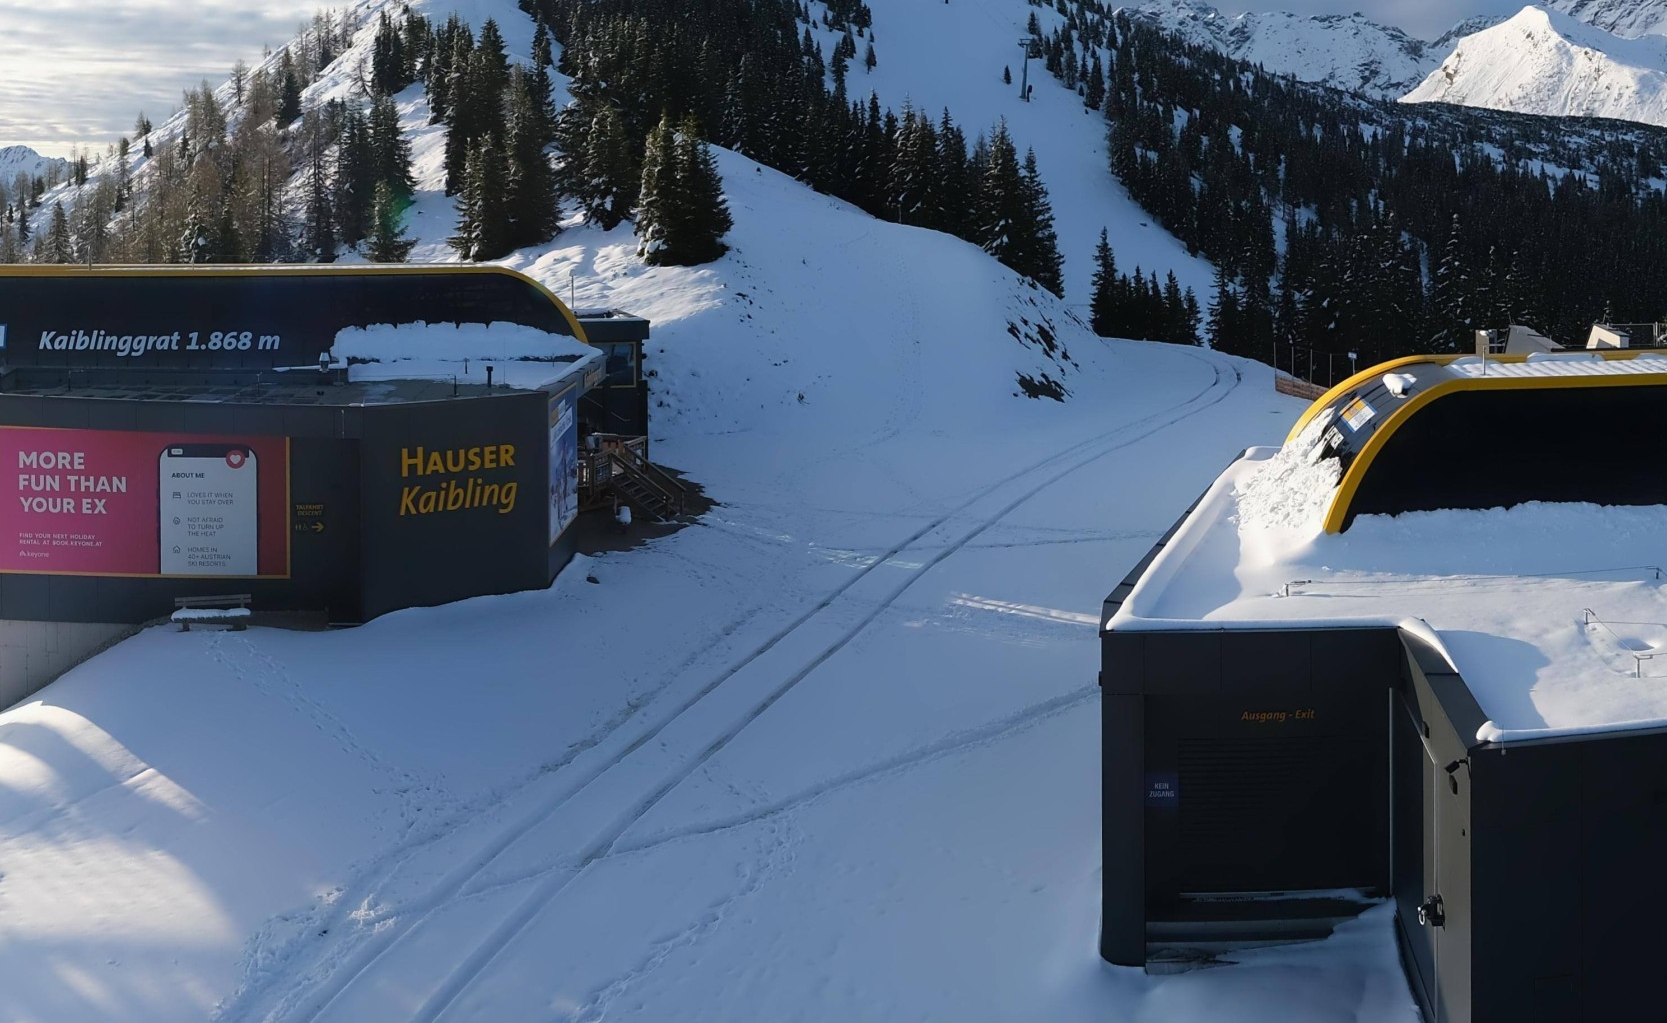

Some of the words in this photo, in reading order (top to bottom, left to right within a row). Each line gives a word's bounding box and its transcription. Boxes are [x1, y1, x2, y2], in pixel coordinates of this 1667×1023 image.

[38, 330, 181, 357] Kaiblinggrat
[186, 331, 252, 351] 1.868
[257, 333, 281, 351] m
[18, 451, 85, 470] MORE
[401, 444, 515, 477] HAUSER
[18, 474, 60, 492] FUN
[66, 475, 127, 493] THAN
[19, 496, 75, 514] YOUR
[82, 498, 107, 515] EX
[400, 477, 518, 516] Kaibling
[1241, 711, 1286, 723] Ausgang
[1295, 708, 1316, 719] Exit
[1149, 790, 1175, 798] ZUGANG
[1154, 782, 1169, 790] KEIN
